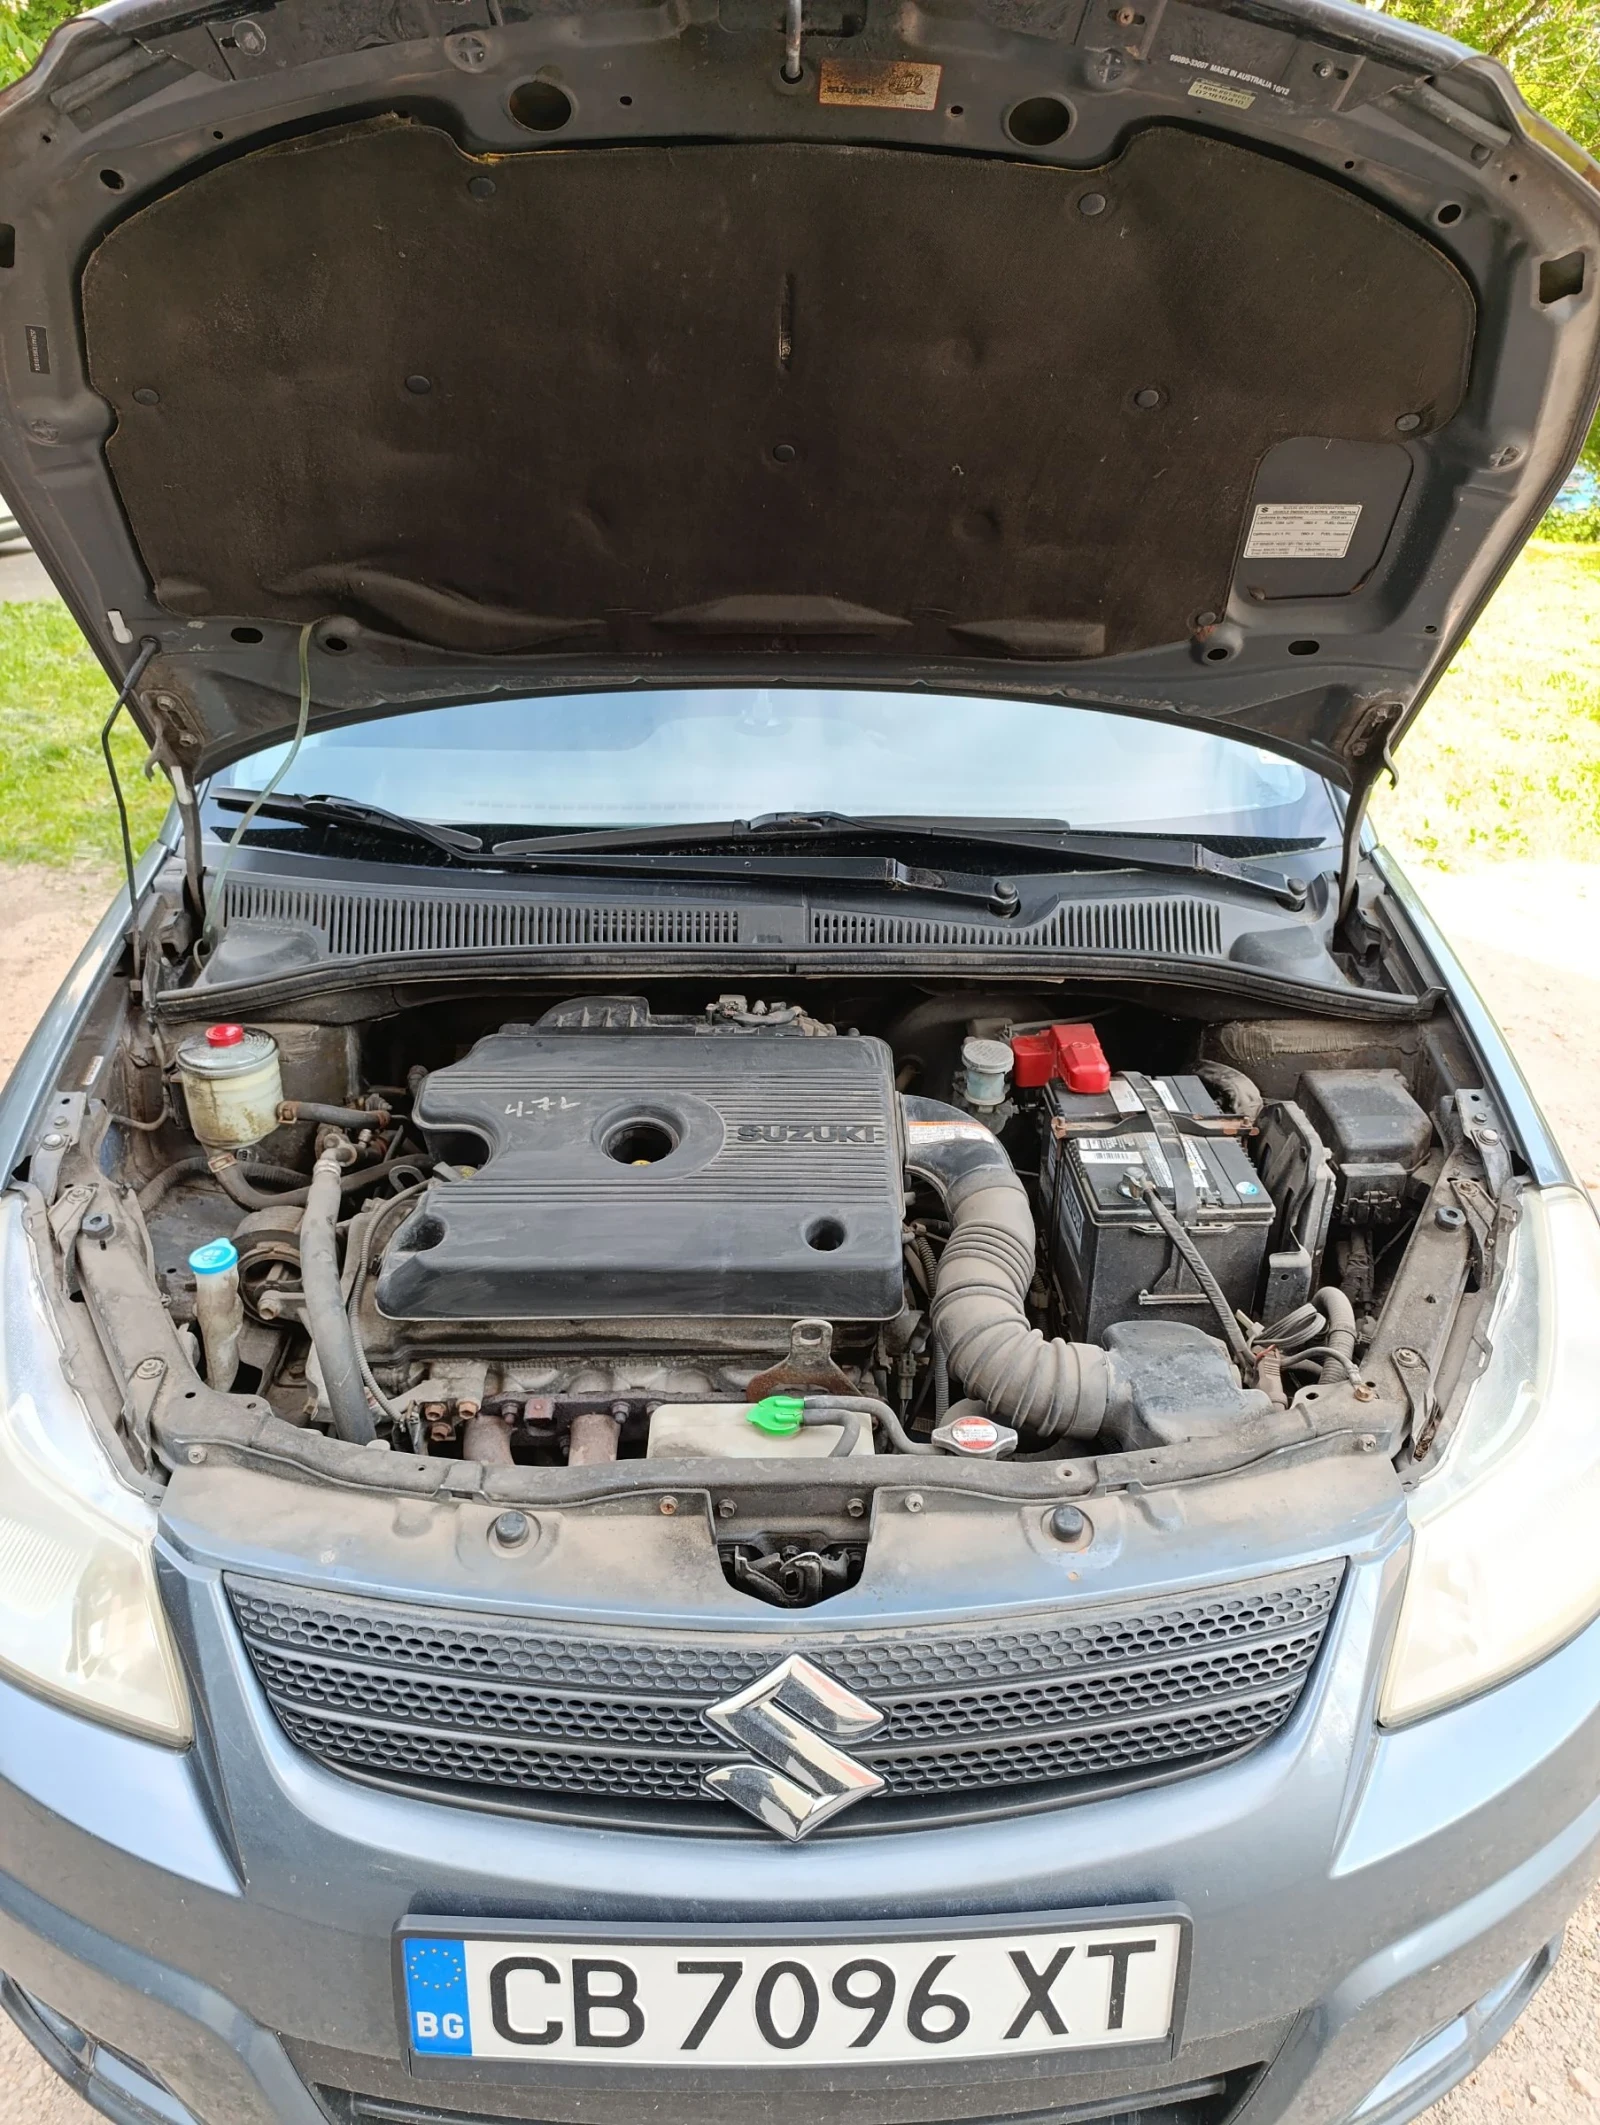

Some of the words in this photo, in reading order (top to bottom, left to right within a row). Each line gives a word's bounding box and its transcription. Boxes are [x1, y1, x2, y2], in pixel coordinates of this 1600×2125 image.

[1210, 64, 1230, 76] MADE
[1230, 69, 1238, 78] IN
[1237, 72, 1272, 89] AUSTRALIA
[827, 85, 876, 95] SUZUKI
[736, 1125, 876, 1144] SUZUKI
[488, 1955, 645, 2050] CB
[675, 1953, 971, 2051] 7096
[1001, 1939, 1158, 2041] XT
[416, 2010, 466, 2039] BG
